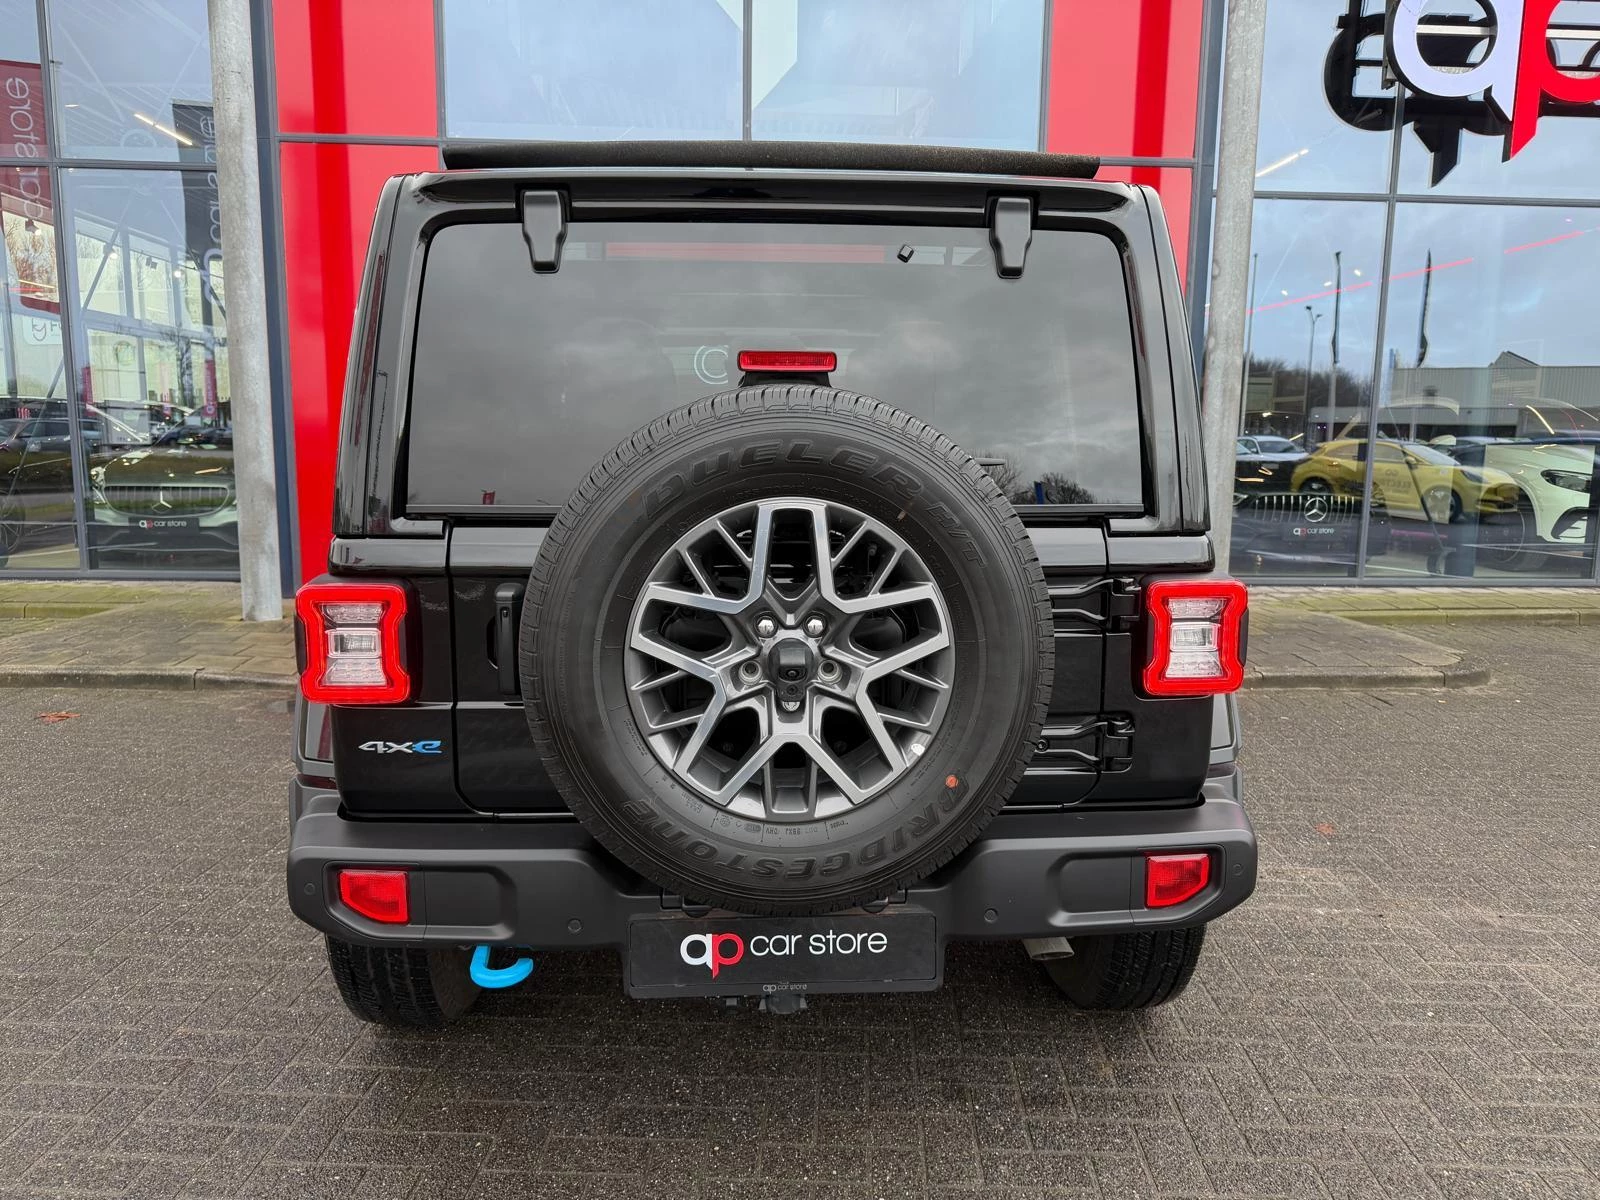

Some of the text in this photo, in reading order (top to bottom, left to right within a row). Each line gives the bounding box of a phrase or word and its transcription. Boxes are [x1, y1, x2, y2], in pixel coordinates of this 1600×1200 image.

[641, 439, 924, 520] DUELER
[925, 500, 988, 570] H/T
[617, 775, 970, 881] BRIDGESTONE
[679, 929, 888, 980] ap car store
[790, 983, 808, 991] store
